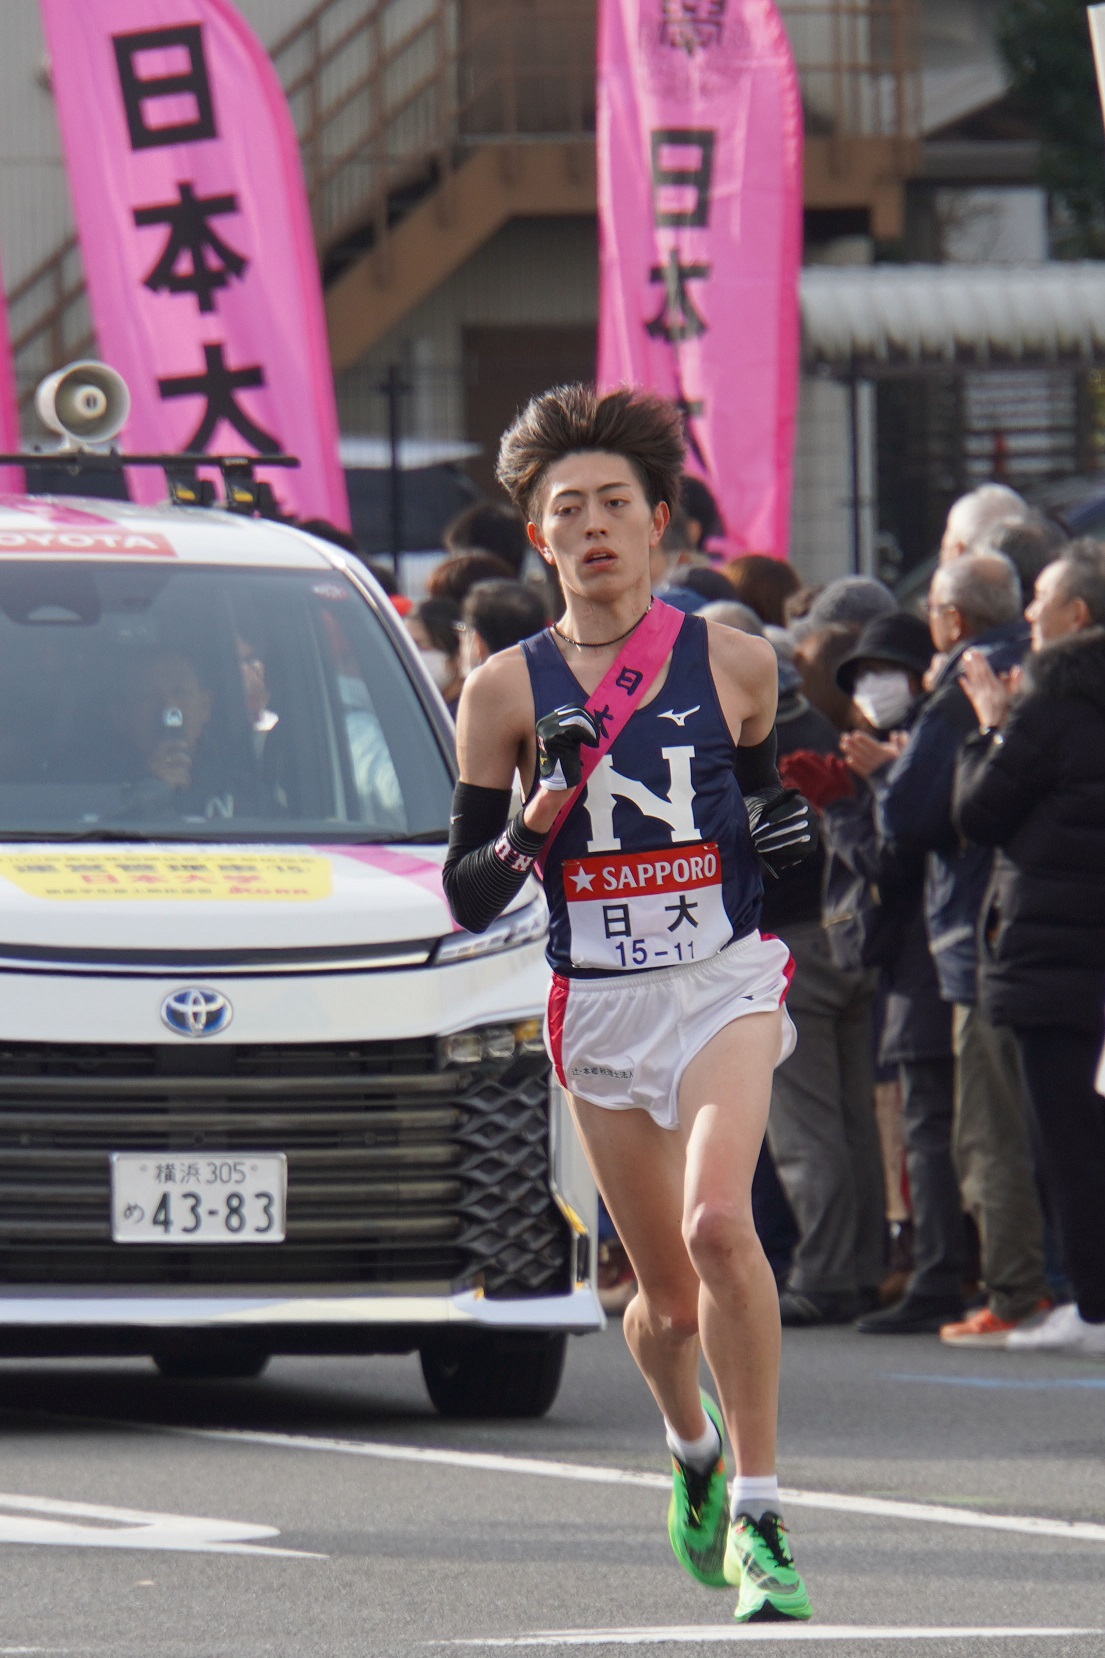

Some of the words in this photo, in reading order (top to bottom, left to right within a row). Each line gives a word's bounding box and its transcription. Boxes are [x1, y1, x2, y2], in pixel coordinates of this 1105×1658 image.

[111, 23, 283, 454] 日本大
[583, 745, 702, 853] N
[602, 854, 717, 891] SAPPORO
[615, 938, 695, 968] 15-11
[123, 1203, 145, 1225] め
[152, 1191, 275, 1234] 43-83
